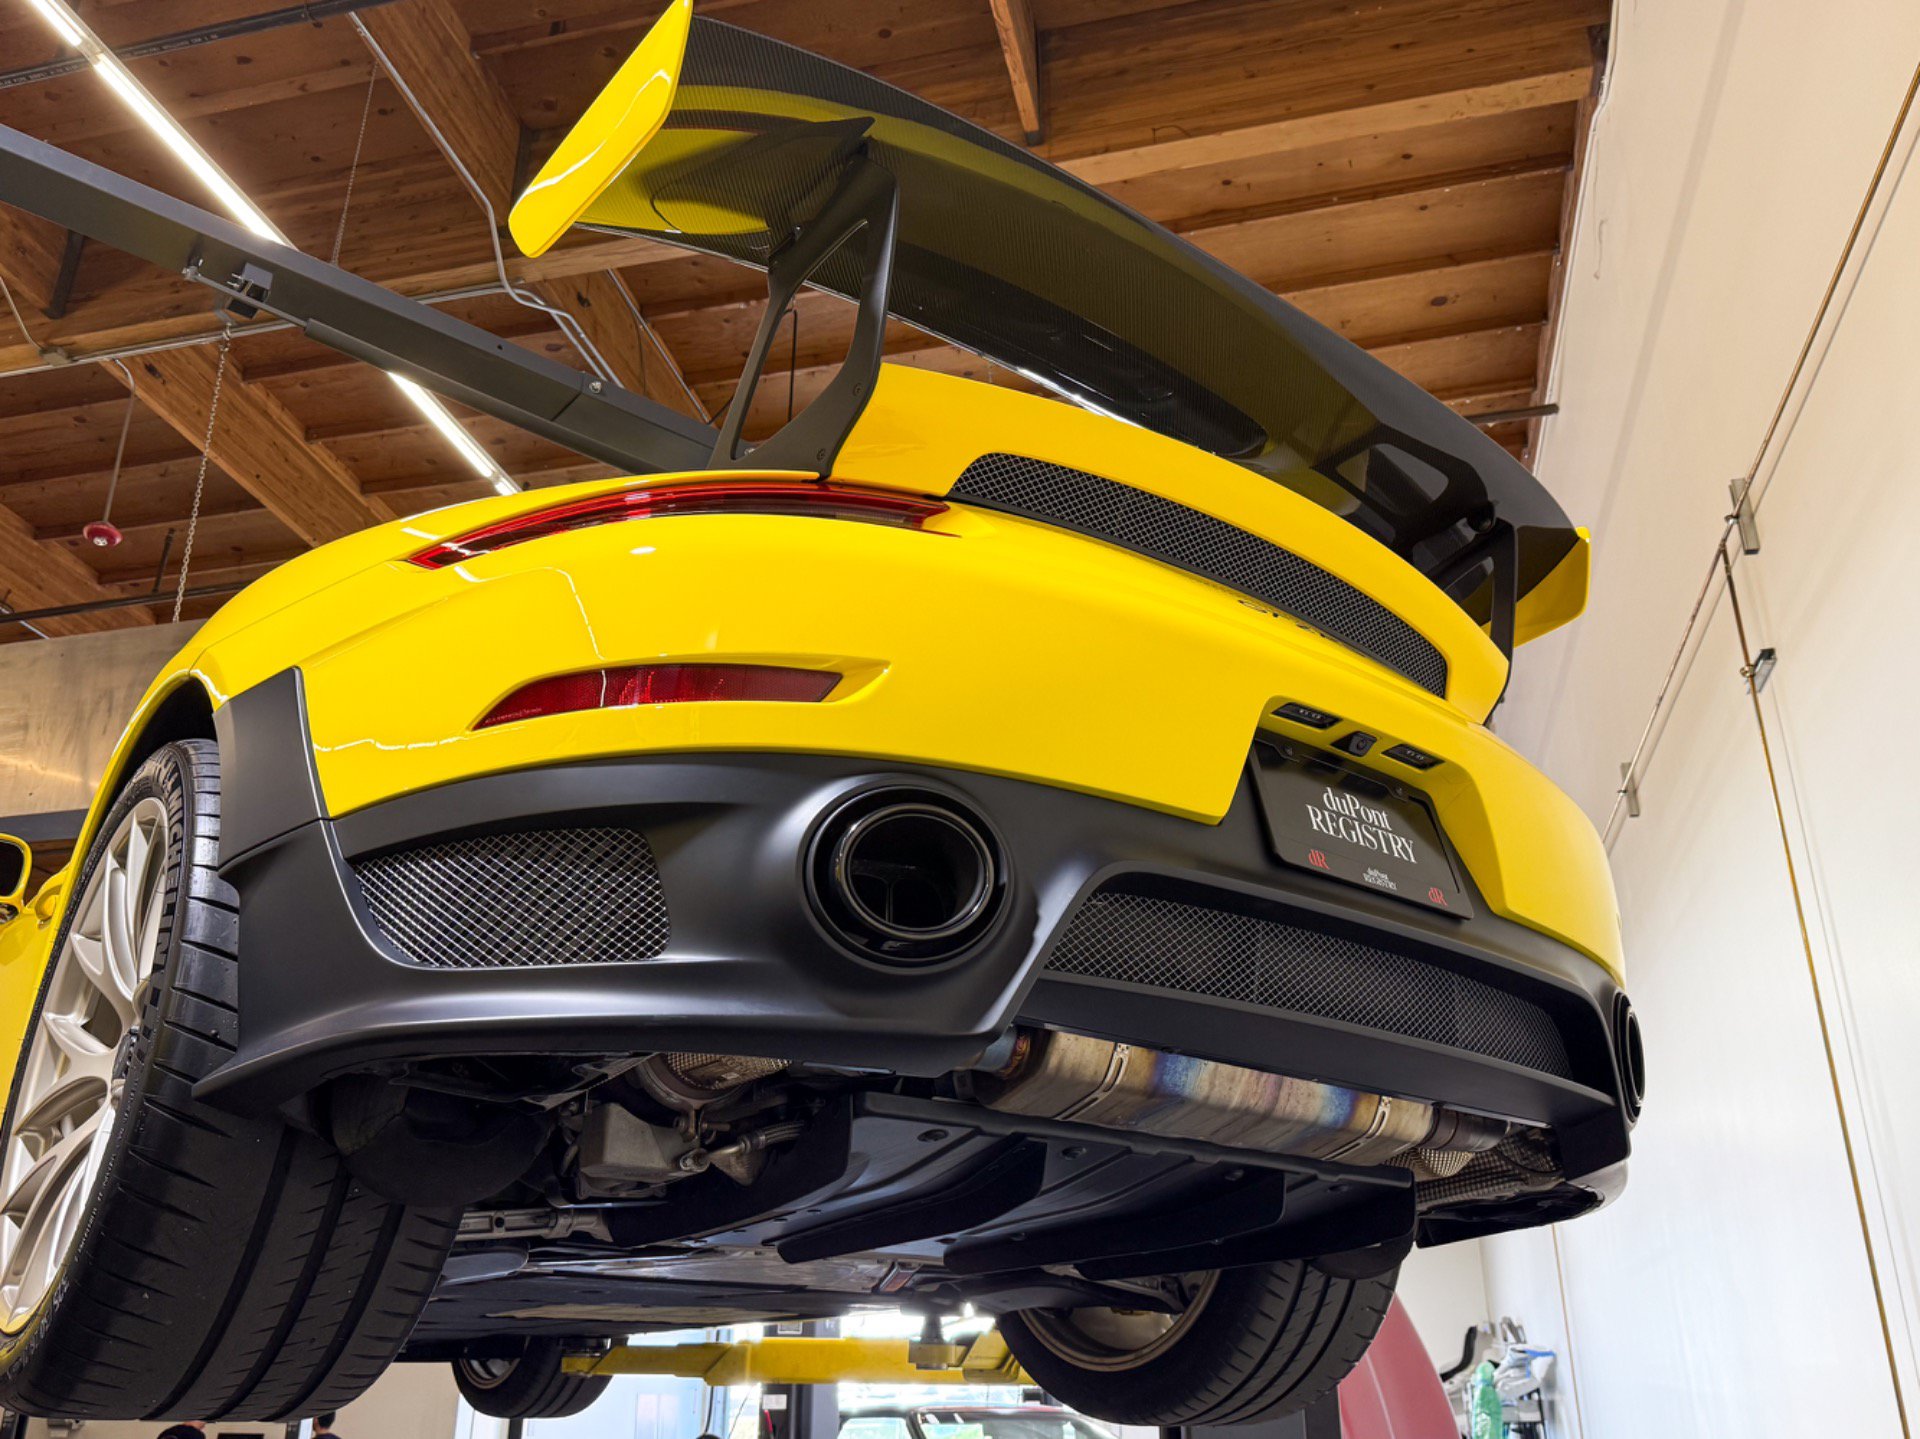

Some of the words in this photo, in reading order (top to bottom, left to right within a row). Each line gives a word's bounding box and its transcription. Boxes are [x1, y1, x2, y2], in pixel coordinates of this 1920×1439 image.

[1305, 803, 1417, 864] REGISTRY
[1323, 786, 1393, 831] duPont
[154, 788, 184, 968] MICHELIN
